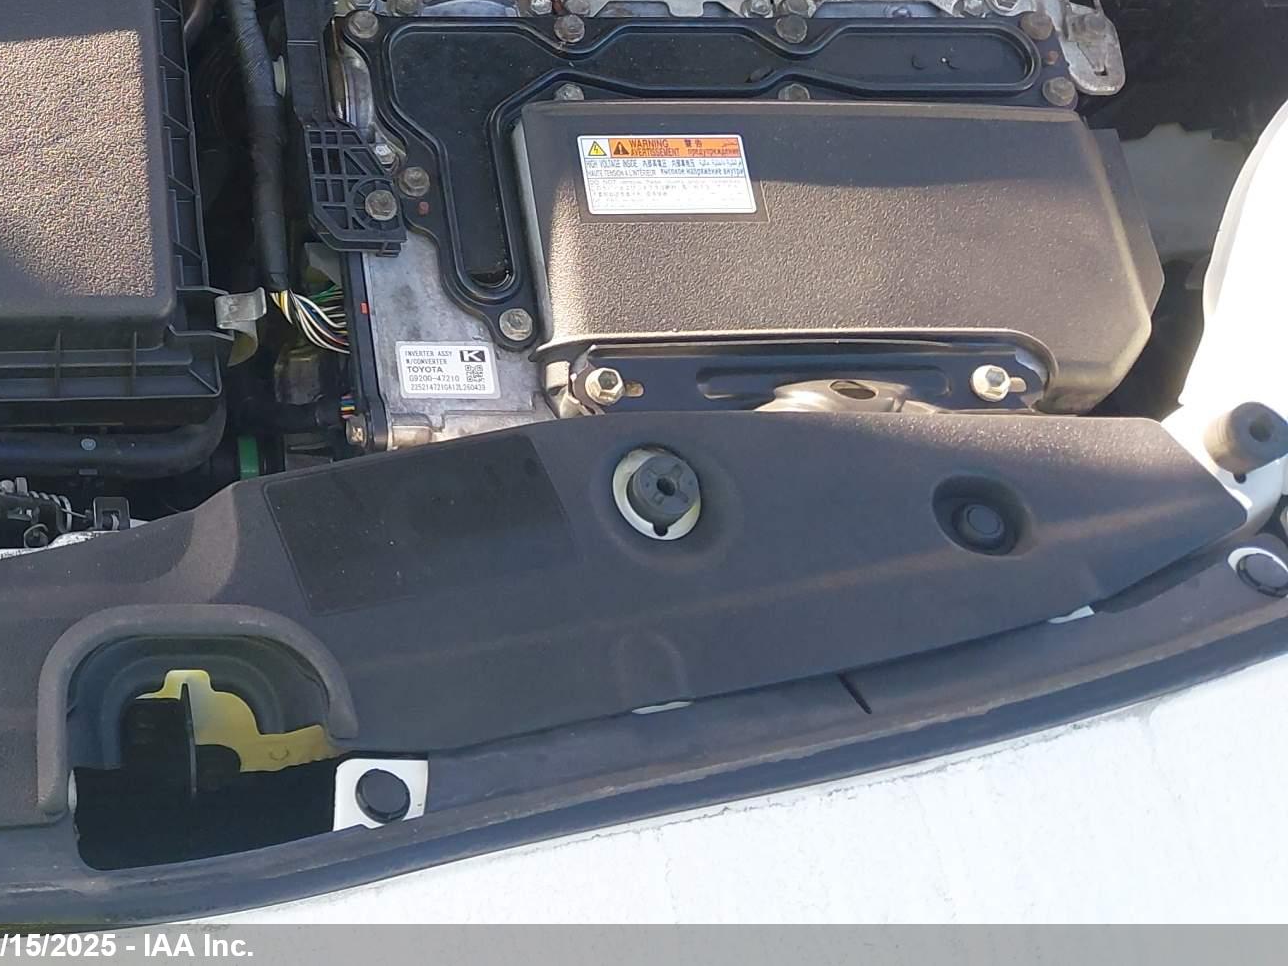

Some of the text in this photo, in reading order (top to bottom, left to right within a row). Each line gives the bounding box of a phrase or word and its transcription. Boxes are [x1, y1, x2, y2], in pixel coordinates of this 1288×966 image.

[628, 139, 668, 147] WARNING
[630, 147, 680, 156] AVERTISSEMENT
[409, 374, 460, 382] G9200-47210
